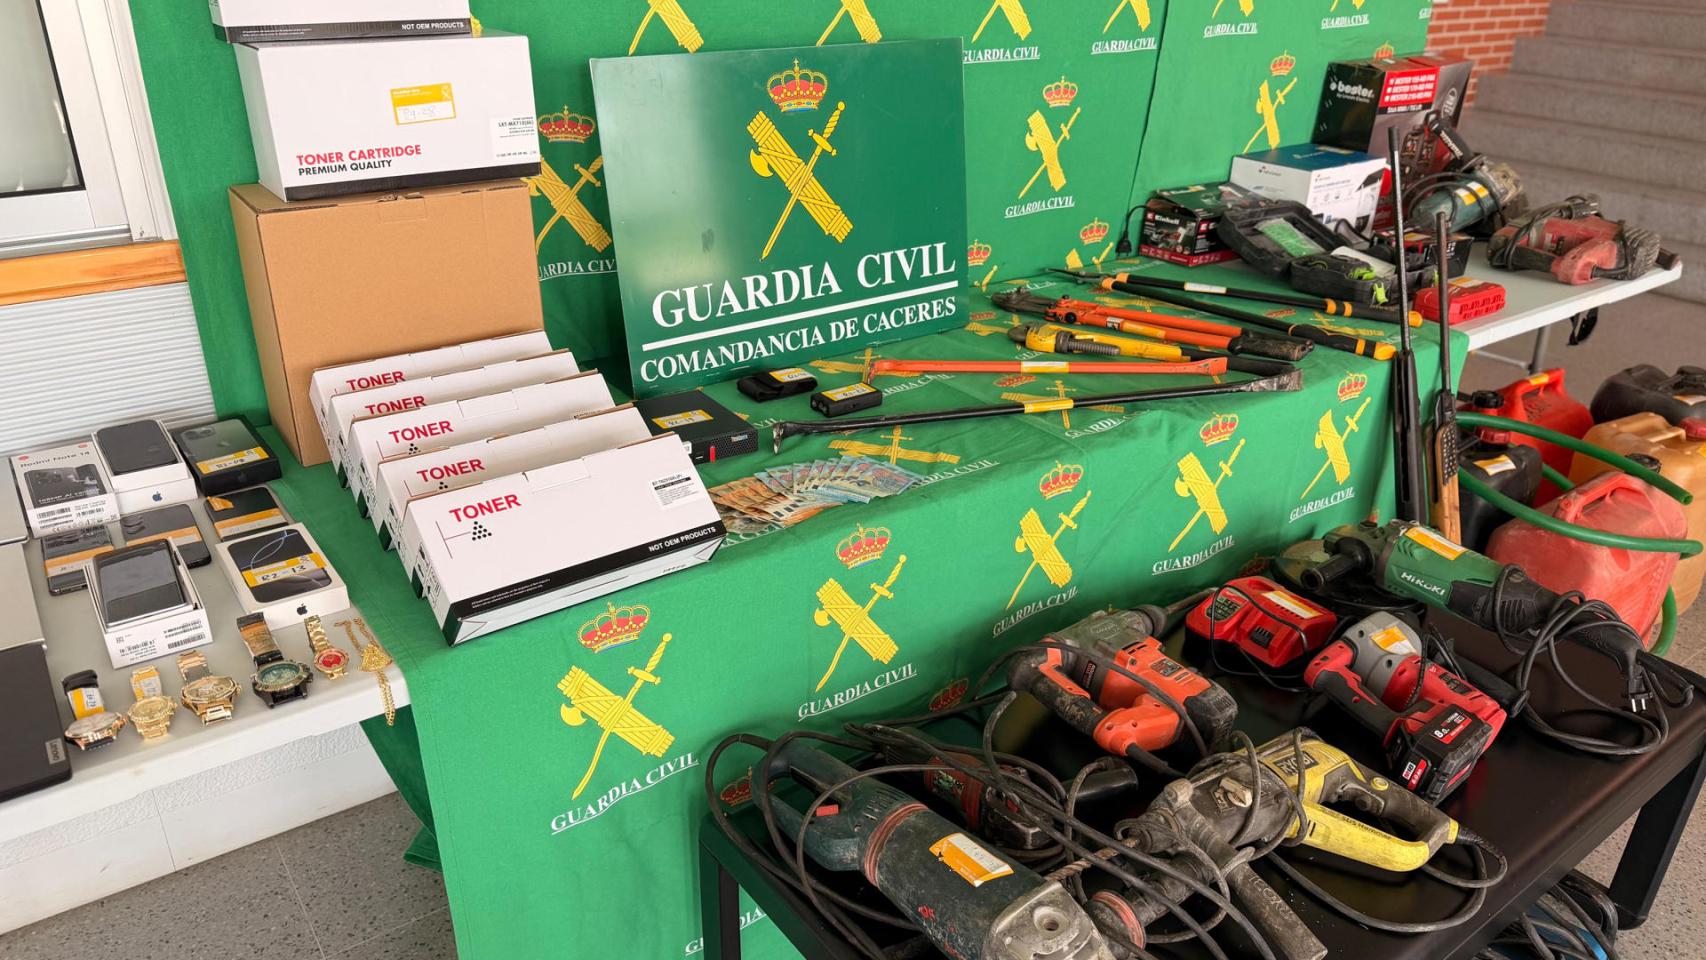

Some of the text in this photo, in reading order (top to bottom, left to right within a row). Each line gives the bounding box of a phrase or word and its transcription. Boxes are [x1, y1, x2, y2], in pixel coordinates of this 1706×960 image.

[417, 23, 429, 31] OEM
[430, 21, 464, 30] PRODUCTS
[1204, 22, 1258, 36] GUARDIA CIVIL
[1321, 14, 1369, 27] GUARDIA CIVIL
[962, 46, 1040, 62] GUARDIA CIVIL
[1091, 37, 1157, 52] GUARDIA CIVIL
[1338, 81, 1373, 98] bester
[296, 145, 422, 166] TONER CARTRIDGE
[298, 159, 392, 177] PREMIUM QUALITY
[1005, 196, 1075, 217] GUARDIA CIVIL
[588, 259, 616, 272] CIV
[652, 241, 956, 328] GUARDIA CIVIL
[640, 296, 956, 383] COMANDANCIA DE CACERES
[346, 371, 406, 391] TONER
[365, 396, 427, 415] TONER
[388, 420, 454, 445] TONER
[20, 459, 51, 468] Redmi
[53, 453, 77, 461] Note
[416, 459, 485, 483] TONER
[954, 459, 1000, 475] CIVIL
[449, 494, 522, 523] TONER
[1289, 487, 1355, 520] GUARDIA CIVIL
[648, 543, 663, 552] NOT
[665, 537, 680, 548] OEM
[680, 526, 716, 545] PRODUCTS
[1152, 535, 1235, 573] GUARDIA CIVIL
[993, 586, 1079, 636] GUARDIA CIVIL
[798, 663, 917, 719] GUARDIA CIVIL
[551, 752, 697, 831] GUARDIA CIVIL
